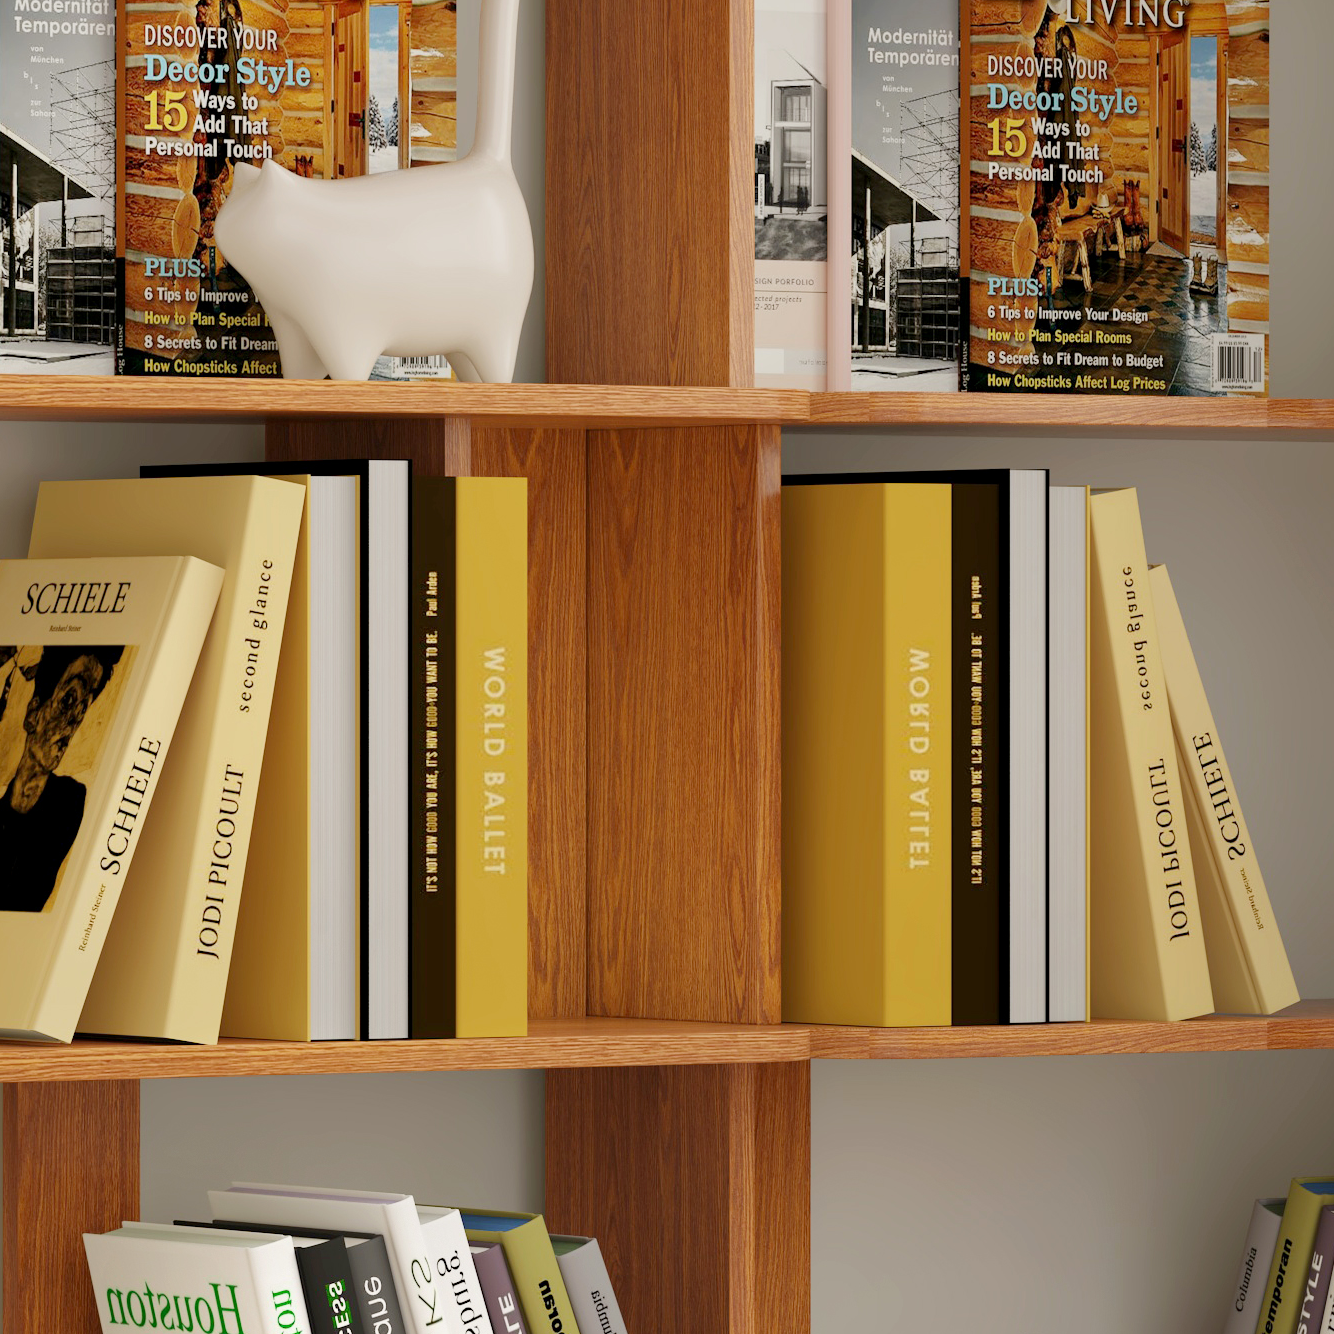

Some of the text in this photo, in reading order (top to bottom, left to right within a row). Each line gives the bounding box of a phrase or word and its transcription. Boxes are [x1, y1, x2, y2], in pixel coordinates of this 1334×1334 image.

[987, 54, 1109, 81] DISCOVER YOUR
[986, 84, 1138, 121] Decor Style
[987, 117, 1028, 159] 15
[1031, 117, 1091, 139] Ways to
[1031, 140, 1101, 162] Add That
[987, 162, 1105, 185] Personal Touch
[986, 276, 1045, 298] PLUS:
[987, 373, 1166, 393] How Chopsticks Affect Log Prices
[20, 582, 132, 615] SCHIELE
[239, 559, 273, 713] second glance
[484, 647, 506, 875] WORLD BALLET
[99, 736, 162, 876] SCHIELE
[196, 763, 244, 959] JODI PICOULT
